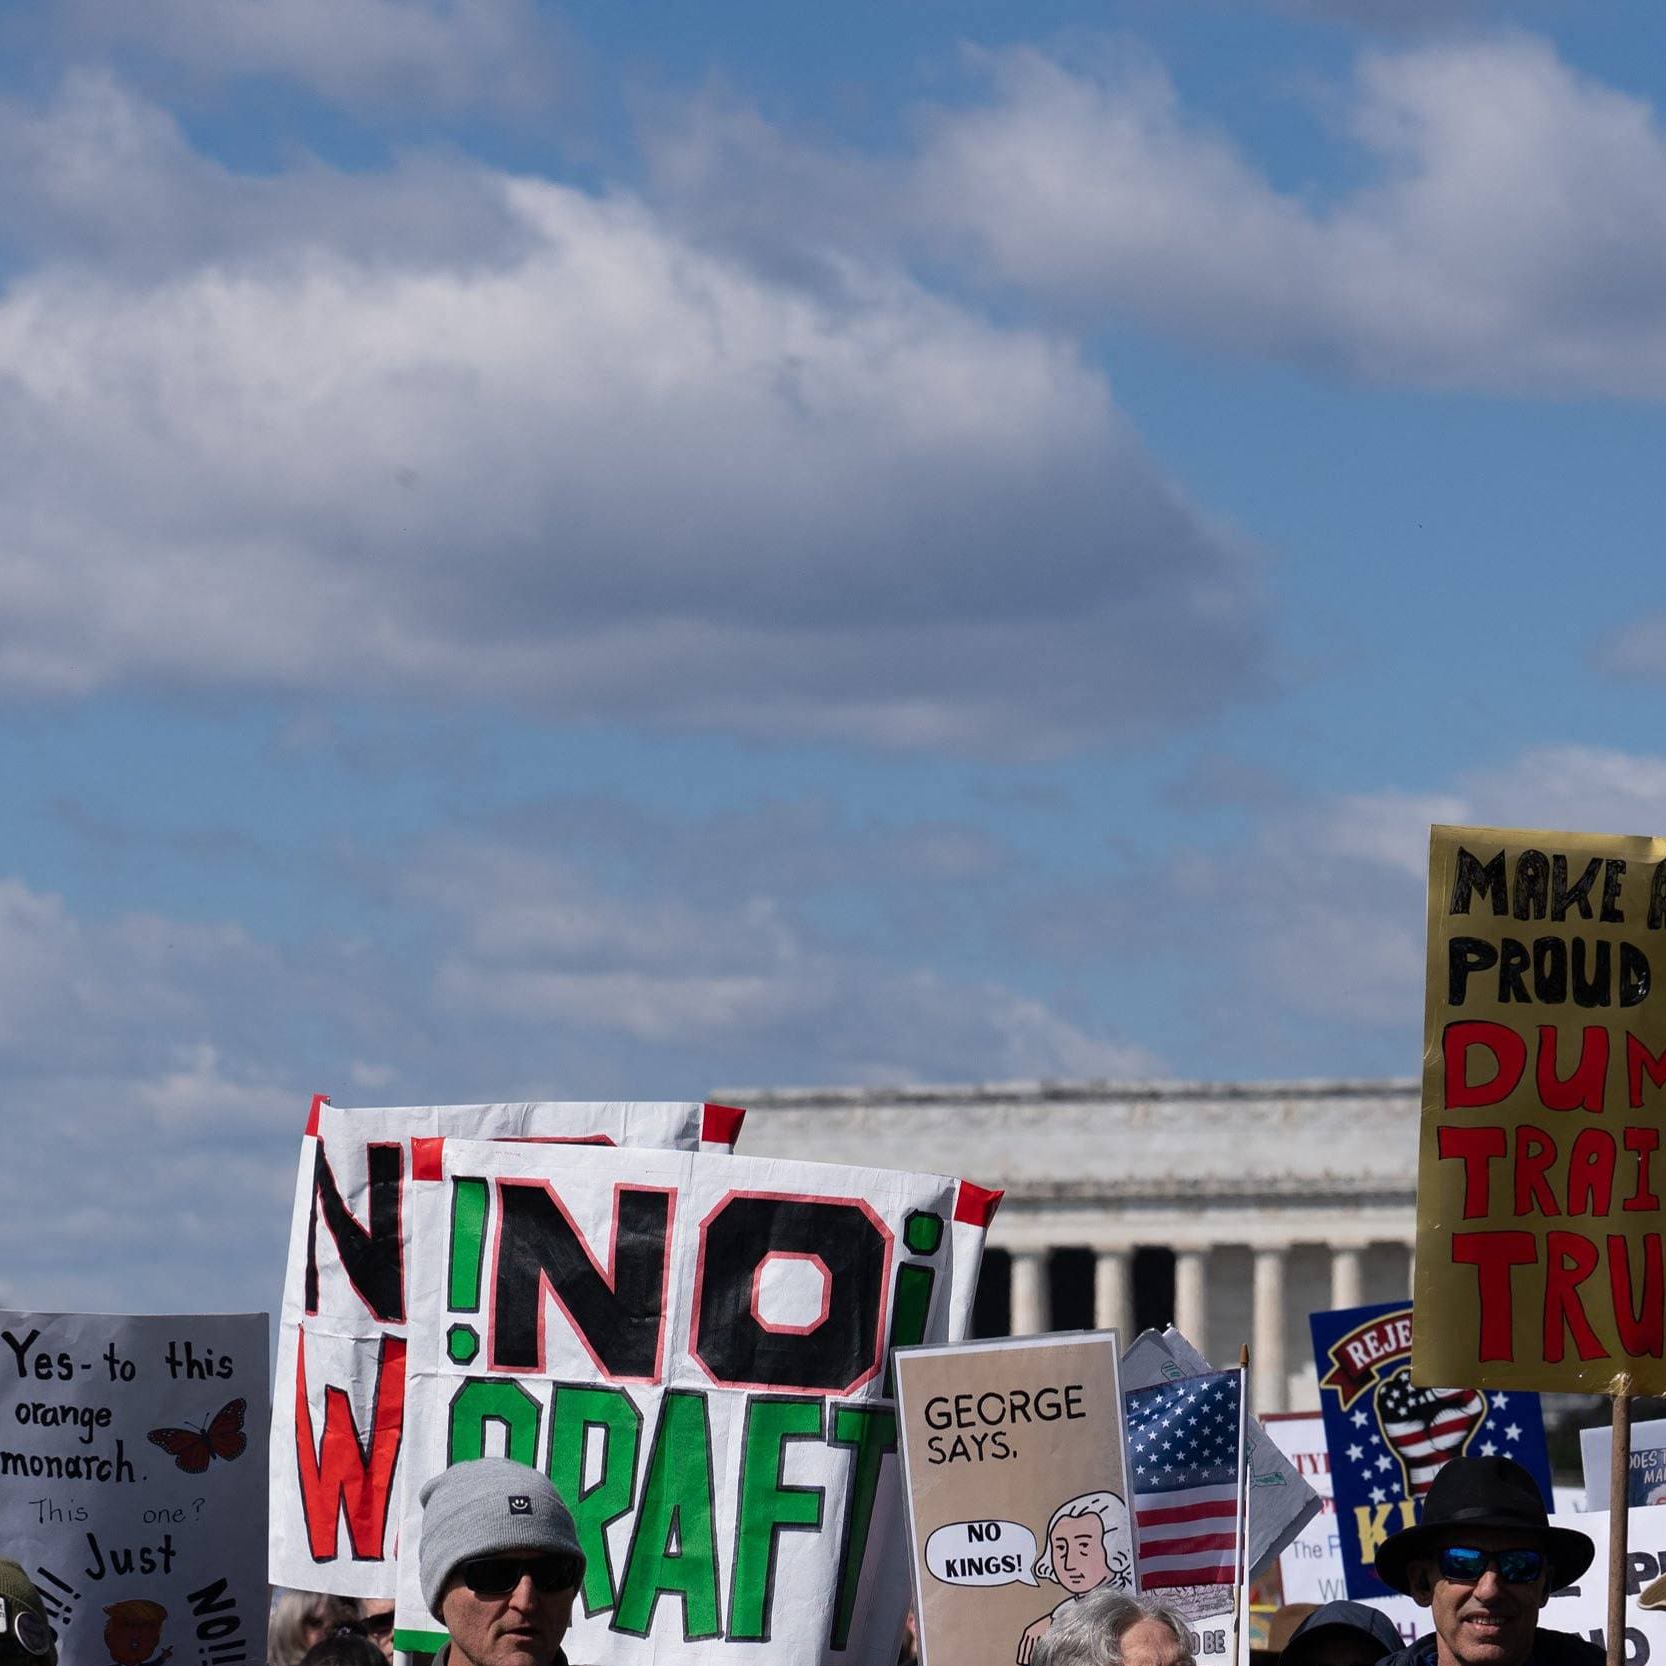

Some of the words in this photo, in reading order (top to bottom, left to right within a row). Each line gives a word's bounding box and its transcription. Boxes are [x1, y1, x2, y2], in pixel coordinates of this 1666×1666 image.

[1449, 846, 1626, 923] MAKE
[1447, 936, 1651, 1008] PROUD
[103, 1342, 136, 1382] to
[165, 1341, 233, 1380] this
[1347, 1319, 1411, 1370] REJE
[15, 1402, 112, 1444] orange
[925, 1384, 1086, 1431] GEORGE
[0, 1440, 147, 1483] monarch.
[29, 1499, 89, 1524] This
[143, 1498, 205, 1523] one?
[967, 1523, 1002, 1543] NO
[1293, 1541, 1323, 1559] The
[86, 1532, 176, 1580] Just
[945, 1554, 1023, 1578] KINGS!
